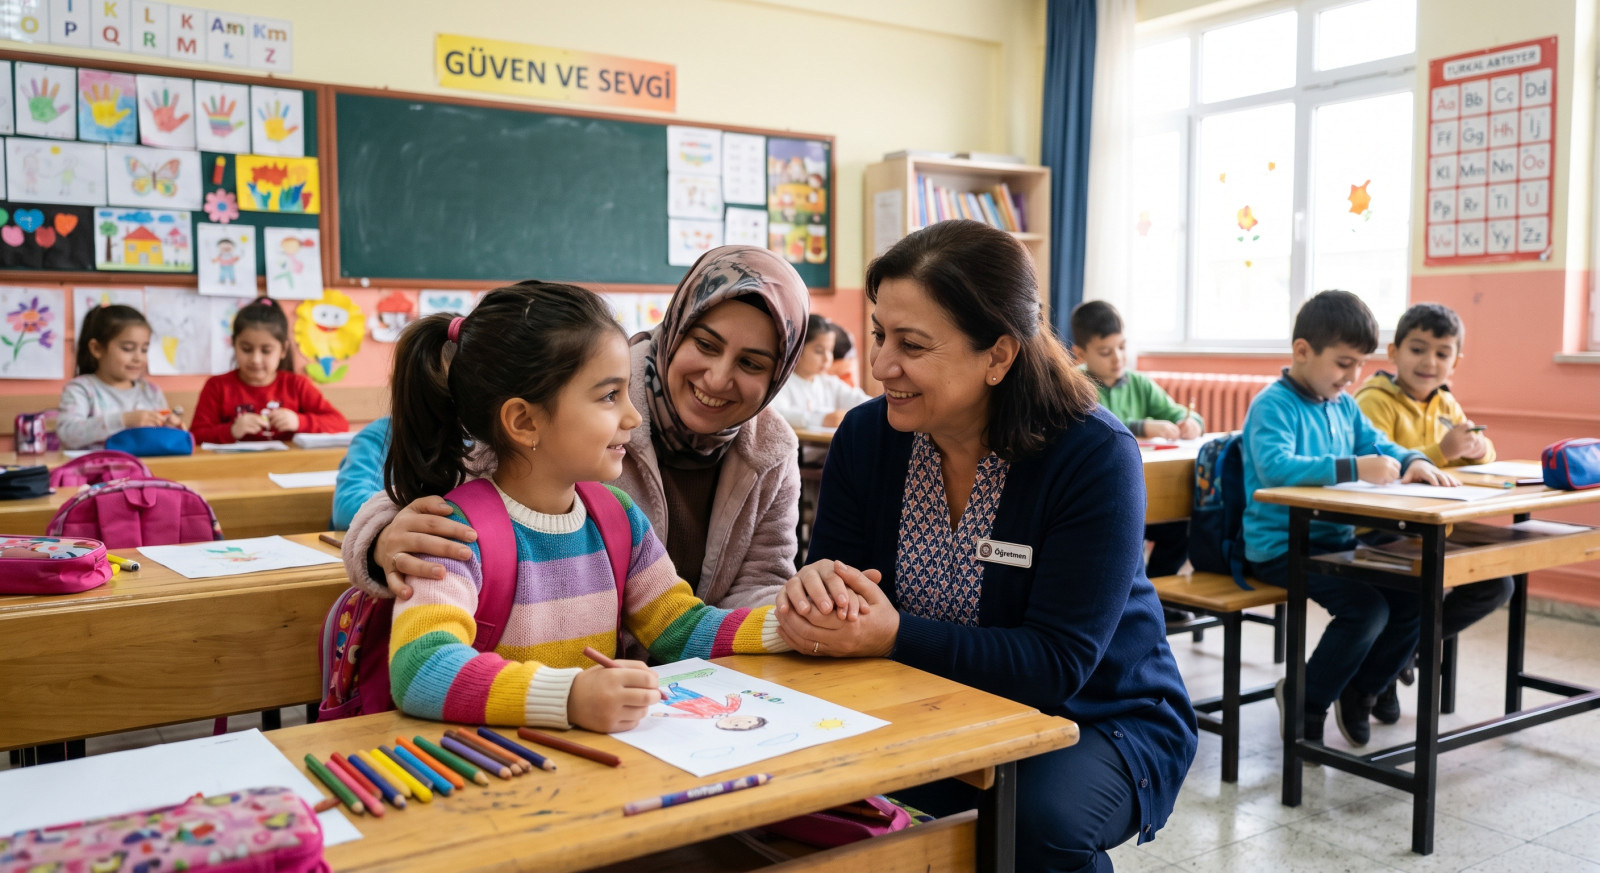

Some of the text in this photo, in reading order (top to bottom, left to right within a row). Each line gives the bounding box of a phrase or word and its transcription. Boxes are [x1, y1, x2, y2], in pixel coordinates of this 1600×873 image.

[103, 1, 118, 18] K
[144, 8, 155, 24] L
[181, 13, 193, 30] K
[211, 17, 245, 36] Am
[253, 23, 287, 41] Km
[21, 16, 39, 34] O
[64, 21, 77, 36] P
[102, 26, 120, 46] Q
[143, 31, 156, 48] R
[177, 37, 197, 54] M
[265, 48, 276, 63] Z
[445, 46, 671, 99] GÜVEN VE SEVGİ
[1436, 98, 1456, 111] Aa
[1464, 92, 1483, 108] Bb
[1525, 80, 1547, 98] Dd
[1437, 130, 1452, 147] Ff
[1462, 127, 1484, 145] Gg
[1493, 122, 1514, 137] Hh
[1460, 163, 1485, 177] Mm
[1492, 160, 1514, 174] Nn
[1522, 154, 1545, 171] Oo
[1433, 200, 1451, 218] Pp
[1464, 197, 1479, 212] Rr
[1462, 232, 1480, 247] Xx
[1493, 230, 1511, 249] Yy
[1523, 227, 1542, 244] Zz
[994, 548, 1027, 559] Öğretmen
